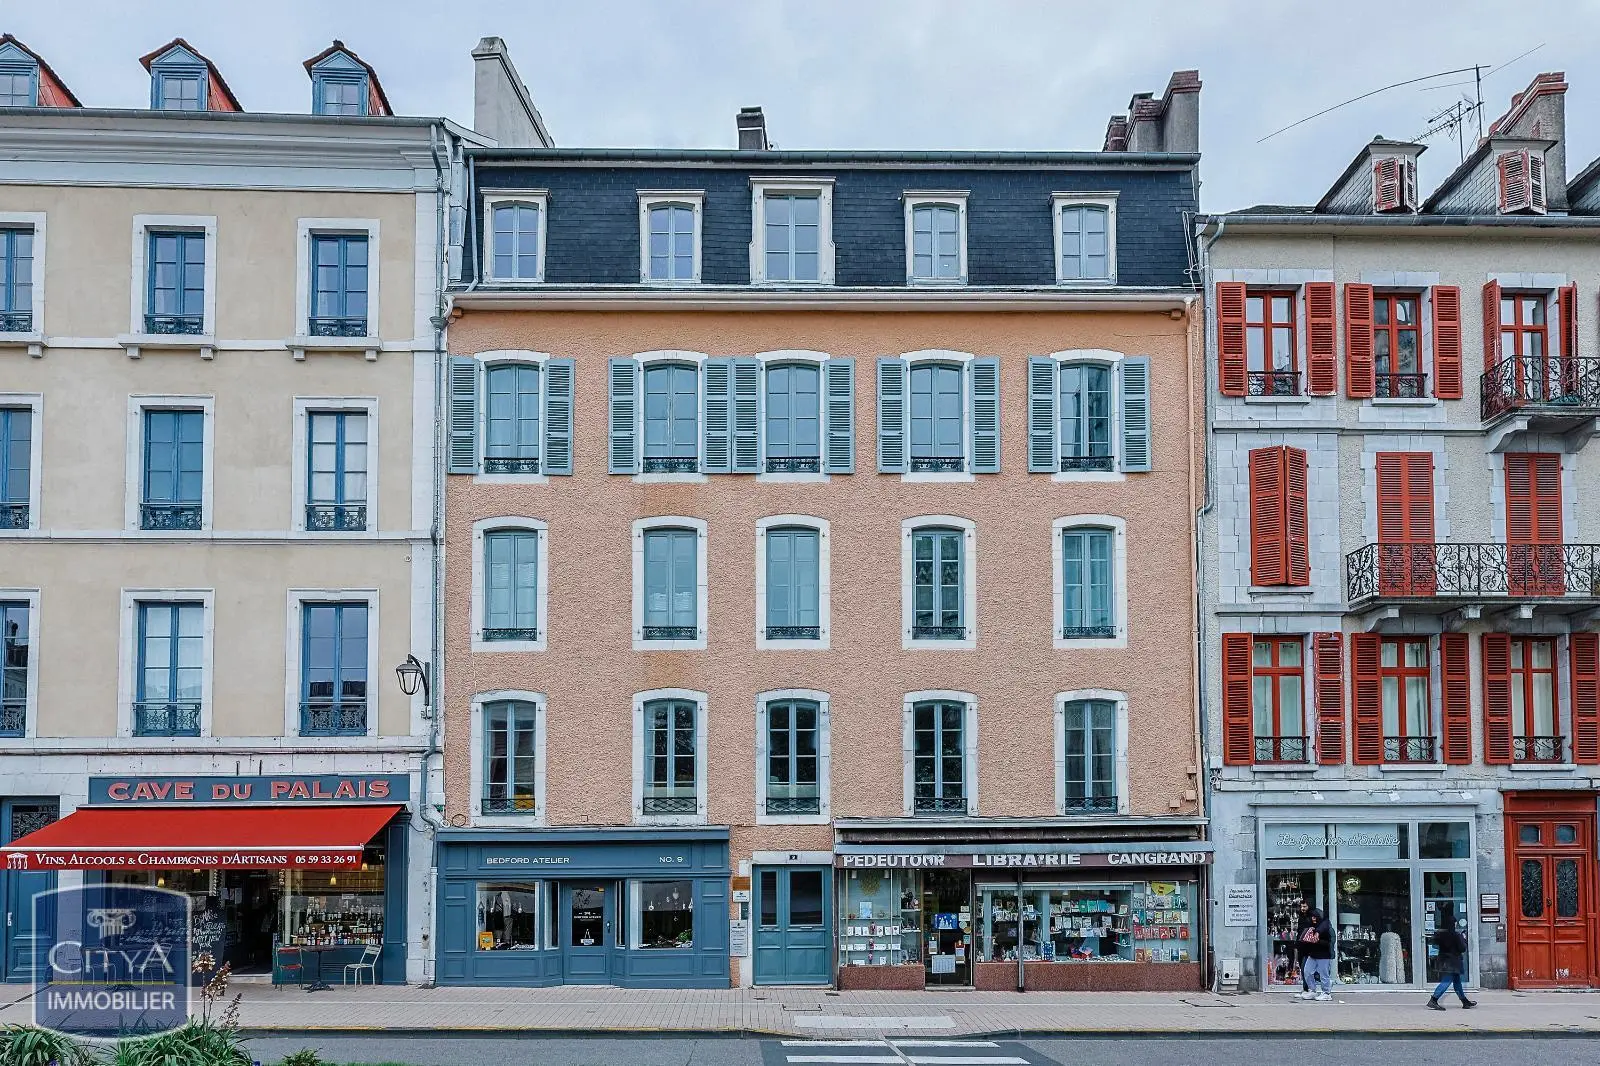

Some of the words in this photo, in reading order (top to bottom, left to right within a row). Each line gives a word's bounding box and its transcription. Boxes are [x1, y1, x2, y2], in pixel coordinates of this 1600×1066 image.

[107, 782, 194, 800] CAVE
[211, 784, 252, 799] DU
[270, 780, 390, 799] PALAIS
[36, 853, 67, 866] VINS,
[69, 854, 125, 865] ALCOOLS
[128, 857, 135, 865] &
[138, 853, 218, 865] CHAMPAGNES
[295, 855, 306, 864] 05
[308, 855, 318, 864] 59
[320, 855, 331, 864] 33
[333, 855, 345, 864] 26
[346, 855, 356, 864] 91
[1107, 852, 1206, 866] CANGRAND
